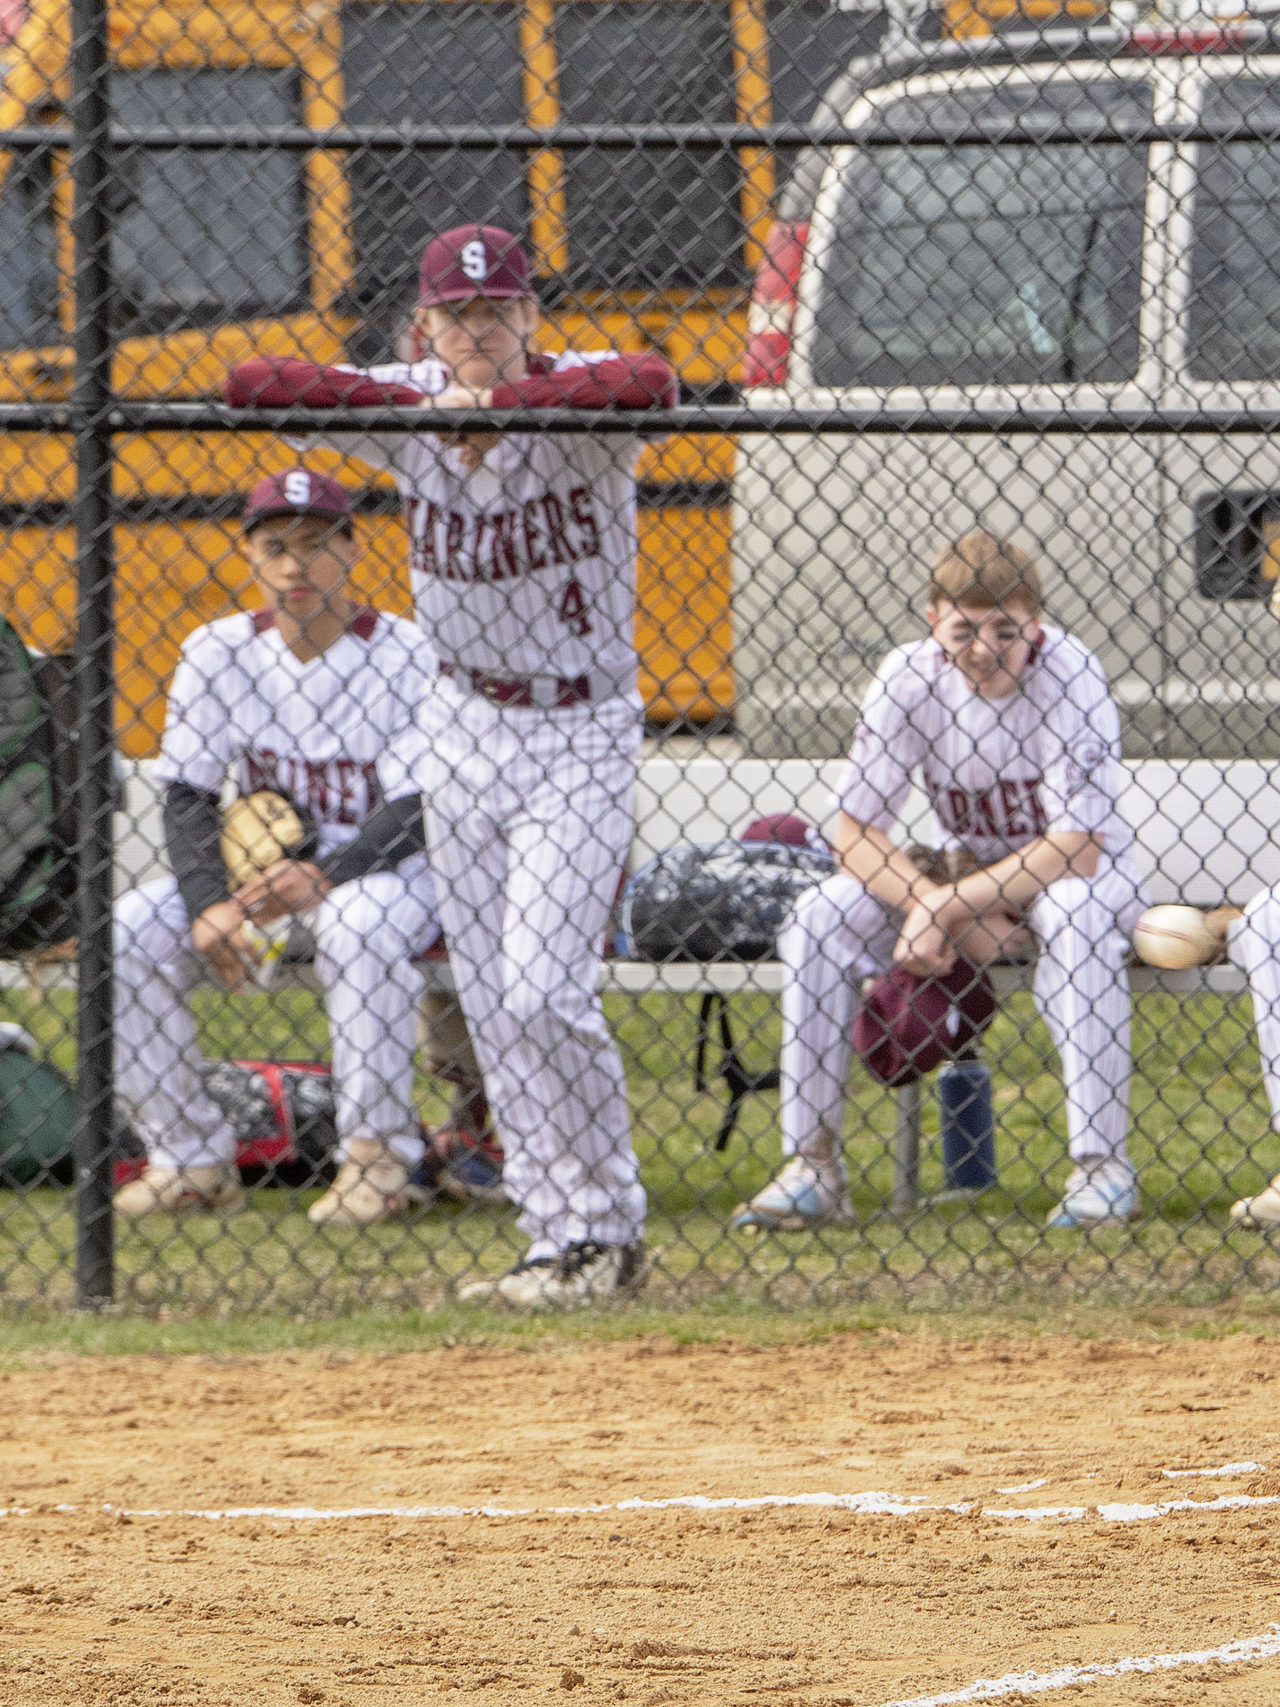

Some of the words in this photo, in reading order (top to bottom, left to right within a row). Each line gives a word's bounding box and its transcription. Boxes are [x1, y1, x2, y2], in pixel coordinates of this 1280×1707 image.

[461, 240, 487, 279] S
[284, 472, 311, 505] S
[559, 580, 592, 636] 4
